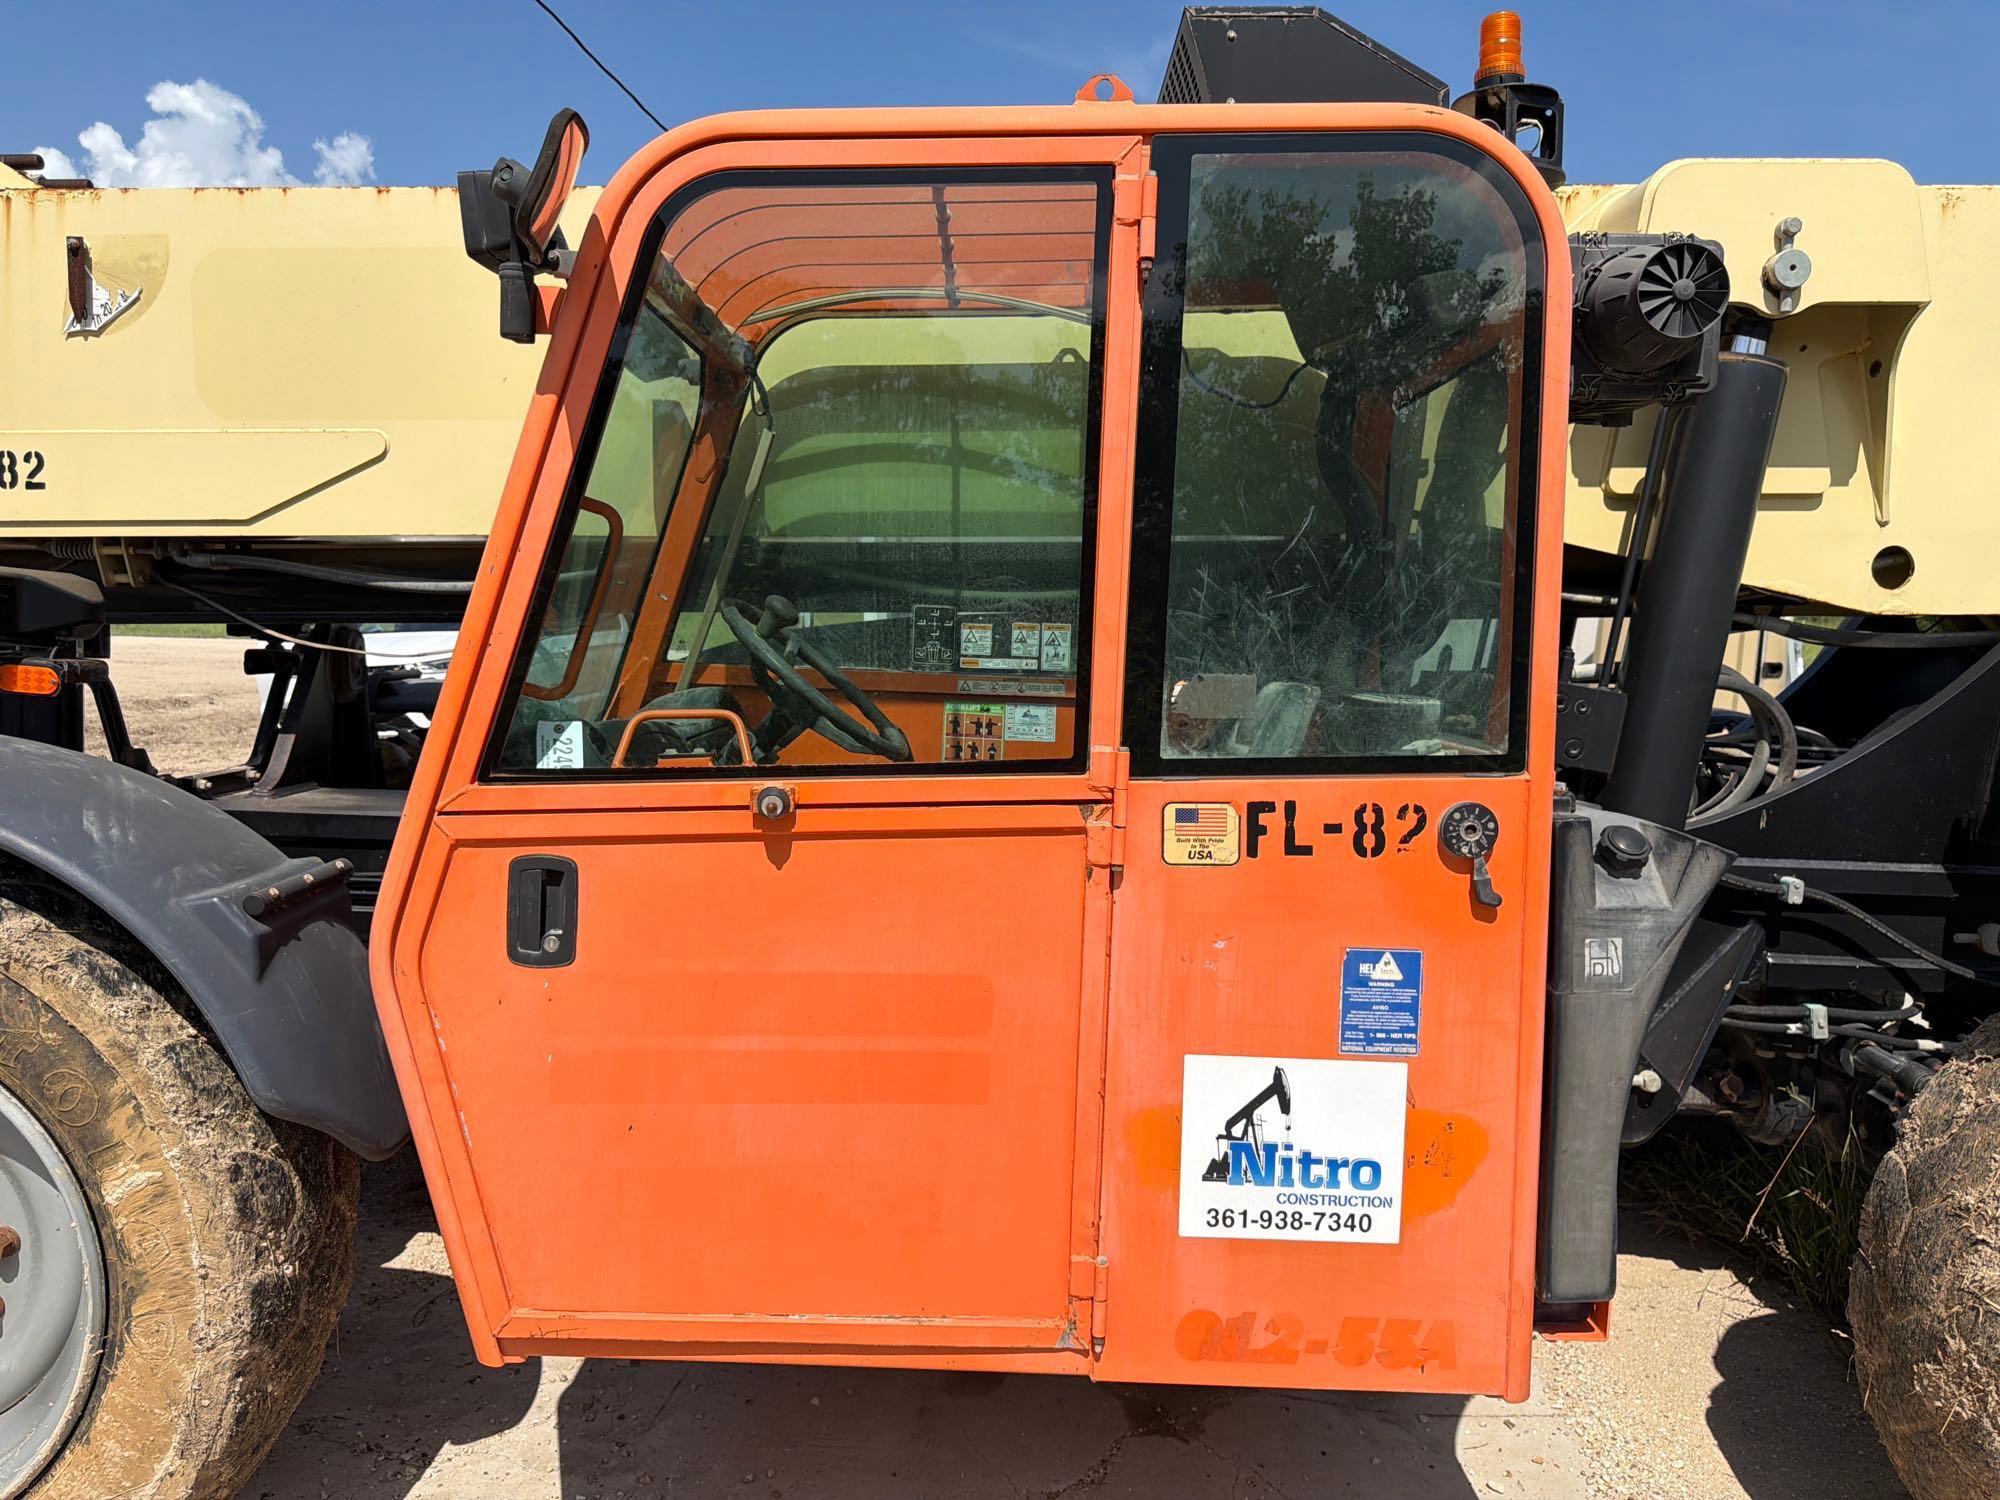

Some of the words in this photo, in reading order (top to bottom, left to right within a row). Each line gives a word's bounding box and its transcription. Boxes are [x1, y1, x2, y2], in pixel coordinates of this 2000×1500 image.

[101, 302, 113, 317] 20
[0, 450, 46, 490] 82
[1246, 800, 1428, 858] FL-82
[1187, 850, 1213, 860] USA
[1224, 1140, 1382, 1191] Nitro
[1276, 1192, 1393, 1208] CONSTRUCTION
[1206, 1208, 1372, 1233] 361-938-7340
